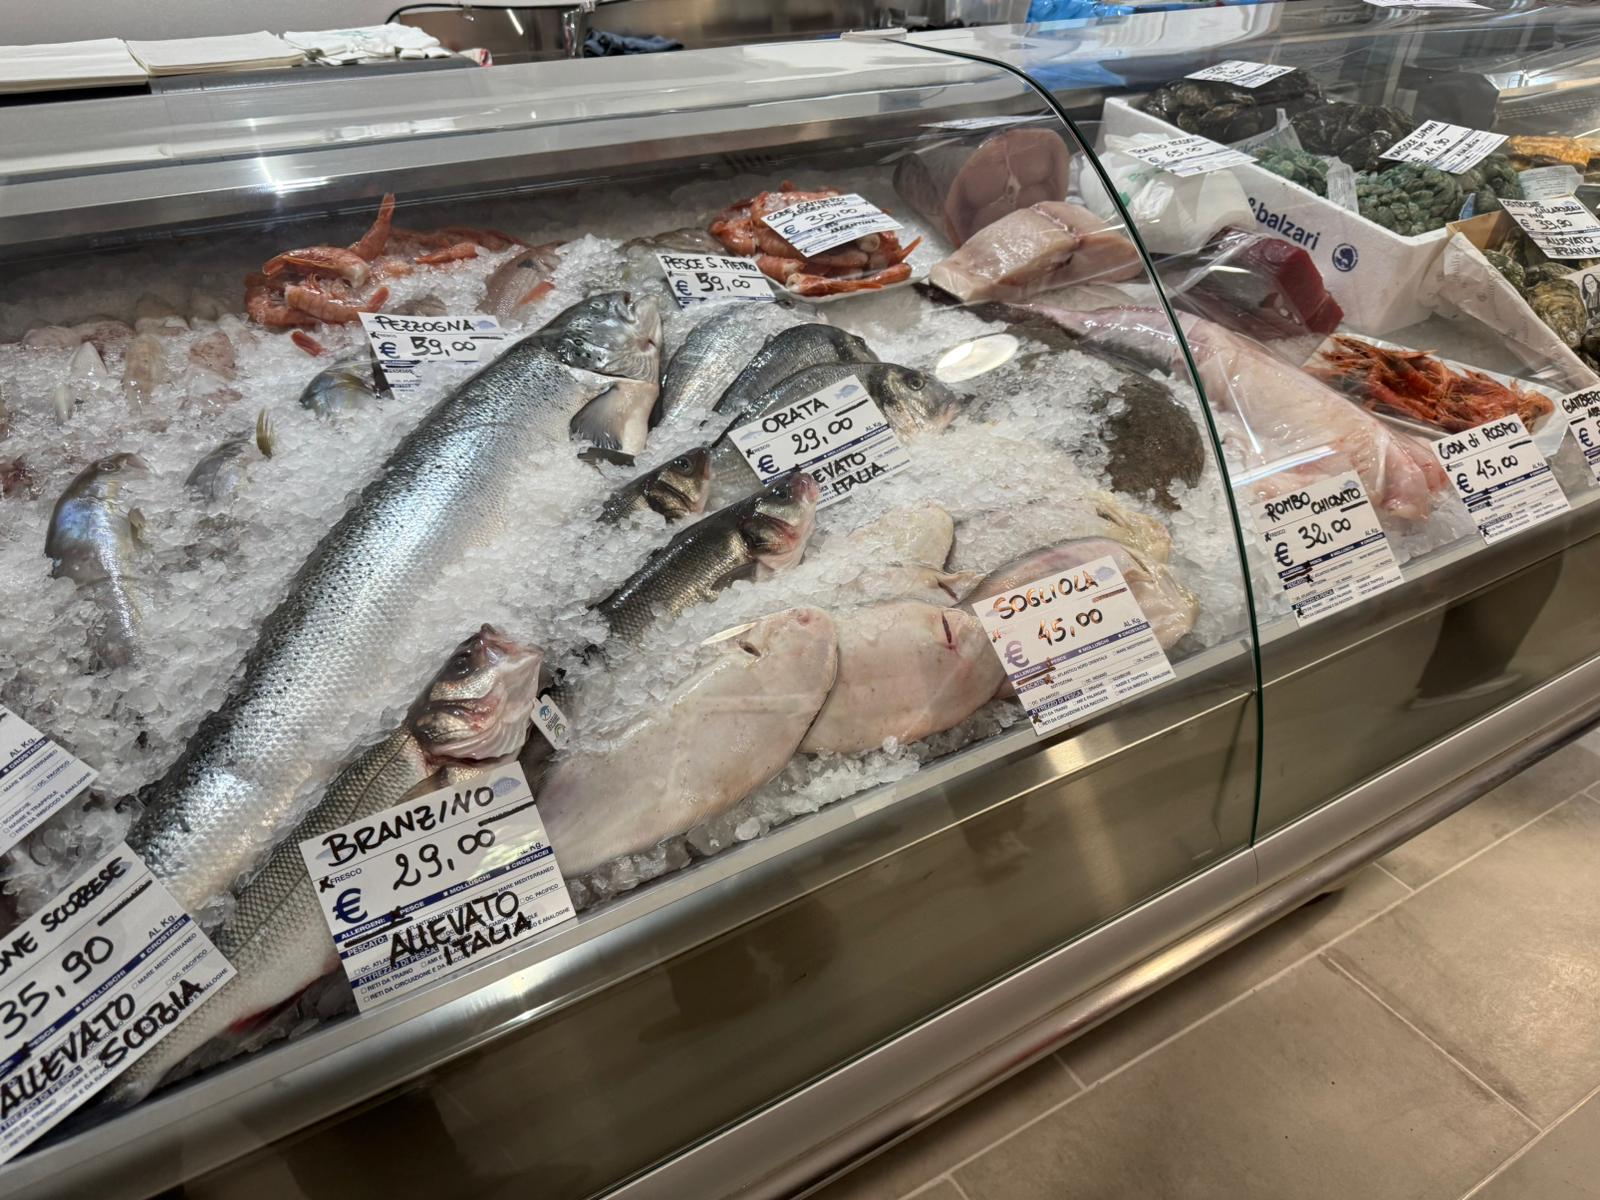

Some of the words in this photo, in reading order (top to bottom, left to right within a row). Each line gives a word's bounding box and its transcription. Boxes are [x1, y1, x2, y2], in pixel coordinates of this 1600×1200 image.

[804, 208, 858, 225] 35,00
[1535, 219, 1573, 231] 39,90
[661, 255, 704, 270] PESCE
[675, 279, 692, 296] €
[375, 315, 475, 332] PEZZOGNA
[379, 342, 401, 359] €
[762, 398, 829, 432] ORATA
[757, 454, 780, 474] €
[792, 417, 853, 455] 29,00
[1438, 440, 1469, 460] CODA
[1468, 432, 1480, 448] di
[1482, 422, 1518, 442] ROSPO
[1579, 428, 1594, 447] €
[1456, 473, 1474, 494] €
[1476, 455, 1518, 479] 45,00
[1264, 491, 1311, 522] ROMBO
[1310, 487, 1361, 515] CHIODATO
[1274, 541, 1294, 566] €
[1298, 518, 1351, 549] 32,00
[993, 570, 1099, 619] SOGLIOLA
[1004, 640, 1029, 668] €
[1038, 608, 1103, 646] 45,00
[10, 749, 20, 757] AL
[20, 737, 37, 751] Kg.
[322, 786, 495, 867] BRANZINO
[331, 868, 362, 884] FRESCO
[334, 888, 368, 924] €
[393, 829, 496, 890] 29,00
[497, 882, 514, 892] MARE
[513, 865, 555, 886] MEDITERRANEO
[339, 916, 386, 939] ALLERGENI:
[399, 900, 425, 915] PESCE
[448, 873, 491, 894] MOLLUSCHI
[510, 849, 549, 868] CROSTACEI
[524, 893, 535, 901] OC.
[534, 883, 559, 897] PACIFICO
[148, 926, 161, 939] AL
[160, 914, 178, 928] Kg.
[541, 906, 570, 922] ANALOGHE
[390, 890, 519, 968] ALLEVATO
[443, 911, 532, 966] ITALIA
[138, 969, 157, 985] MARE
[154, 932, 198, 971] MEDITERRANEO
[346, 935, 387, 956] PESCATO:
[82, 970, 127, 1009] MOLLUSCHI
[147, 918, 186, 953] CROSTACEI
[182, 949, 208, 973] PACIFICO
[360, 964, 371, 972] OC.
[426, 956, 438, 965] AMI
[0, 936, 114, 1039] 35,90
[366, 981, 381, 991] RETI
[390, 967, 413, 980] TRAINO
[369, 989, 384, 1000] RETI
[393, 968, 432, 989] CIRCUIZIONE
[98, 978, 205, 1068] SCOZIA
[1, 993, 135, 1119] ALLEVATO
